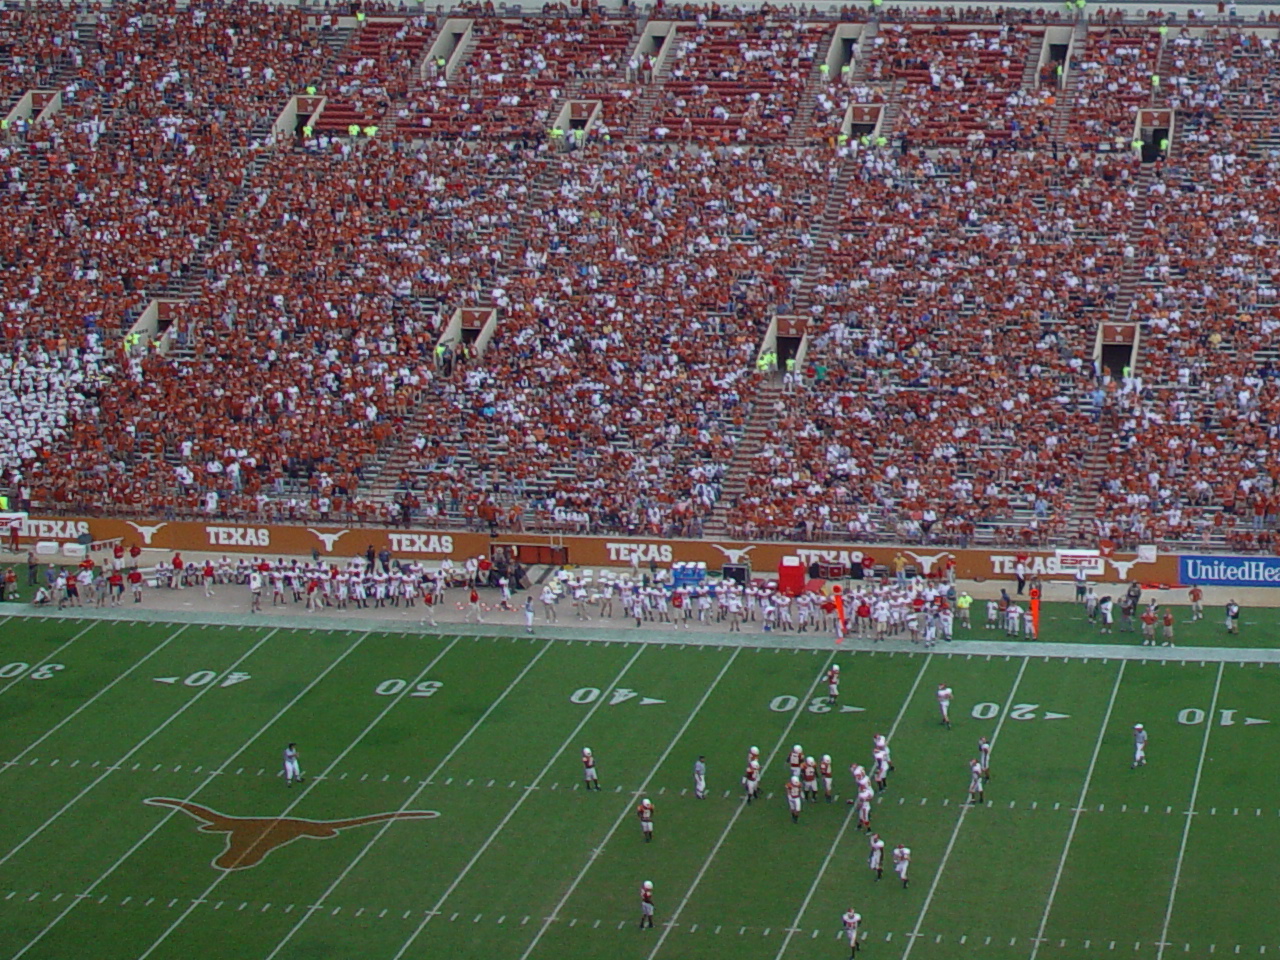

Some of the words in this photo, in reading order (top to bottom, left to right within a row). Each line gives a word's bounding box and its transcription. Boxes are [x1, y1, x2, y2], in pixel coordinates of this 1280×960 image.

[206, 526, 270, 546] TEXAS
[388, 533, 454, 553] TEXAS
[606, 542, 673, 562] TEXAS
[0, 662, 65, 680] 30
[184, 670, 251, 688] 40
[375, 679, 444, 697] 50
[570, 687, 638, 705] 40
[770, 695, 832, 713] 30
[971, 702, 1040, 720] 20
[1178, 708, 1238, 726] 10
